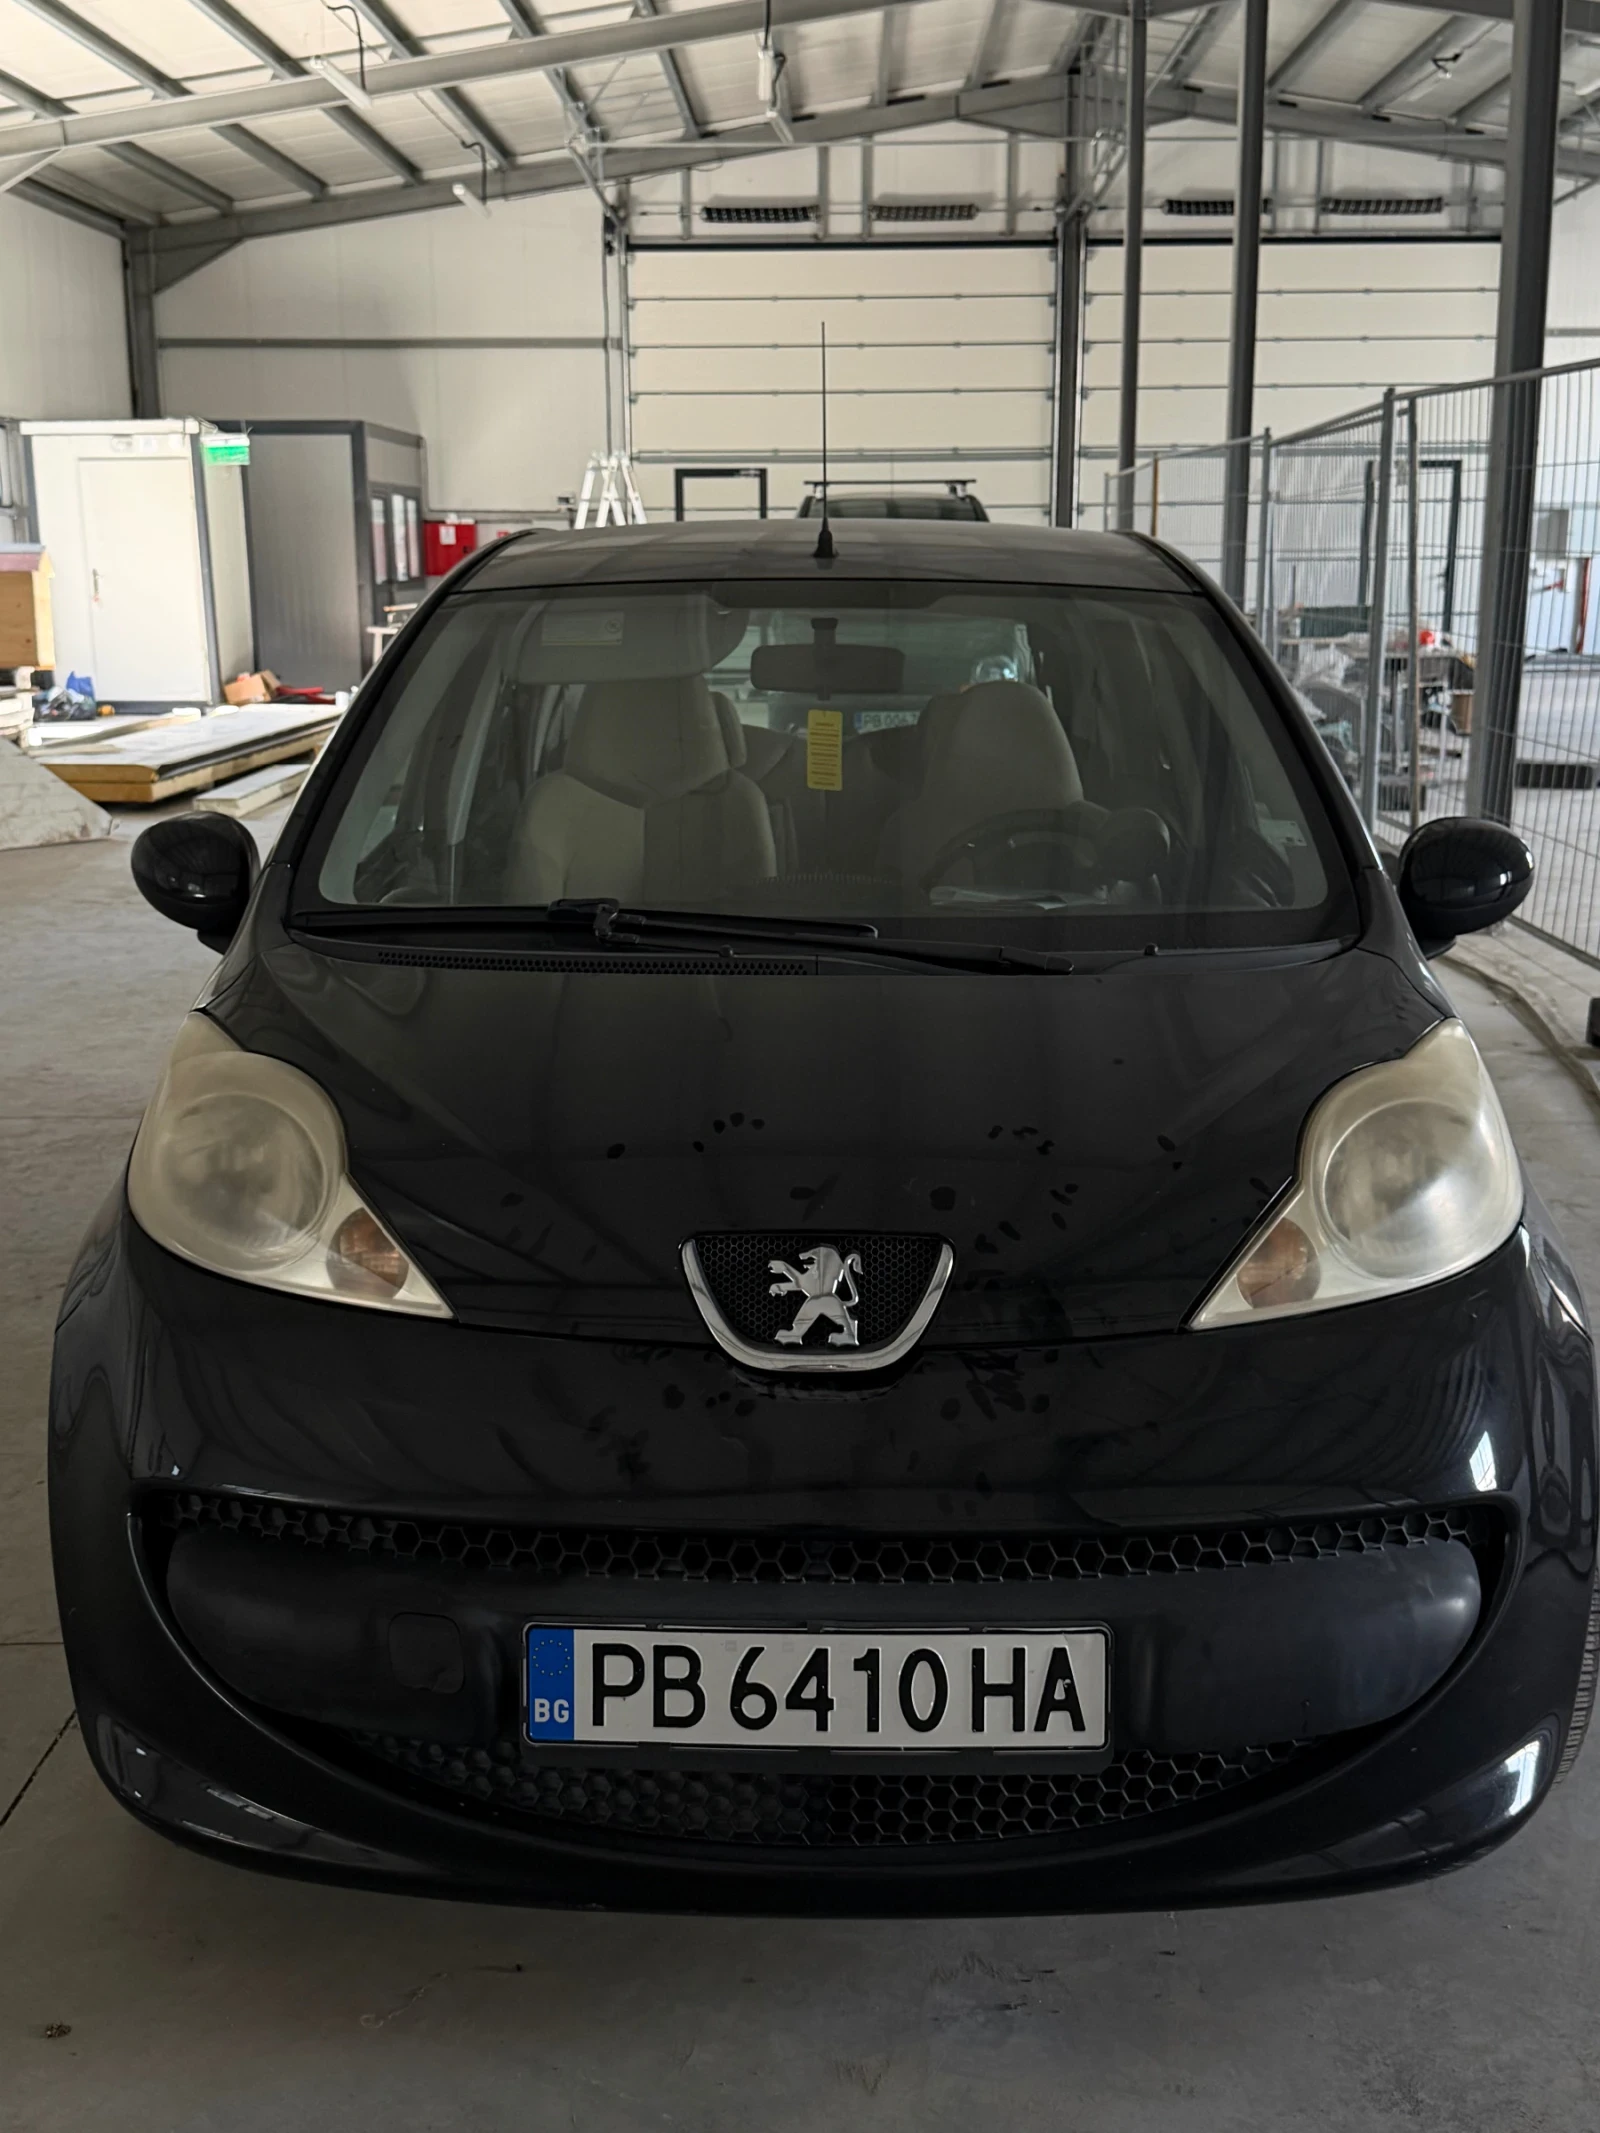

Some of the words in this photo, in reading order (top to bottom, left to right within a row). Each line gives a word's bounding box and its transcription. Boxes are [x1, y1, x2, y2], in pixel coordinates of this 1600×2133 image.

[534, 1697, 570, 1723] BG
[592, 1643, 706, 1728] PB
[729, 1646, 949, 1732] 6410
[971, 1647, 1086, 1732] HA
